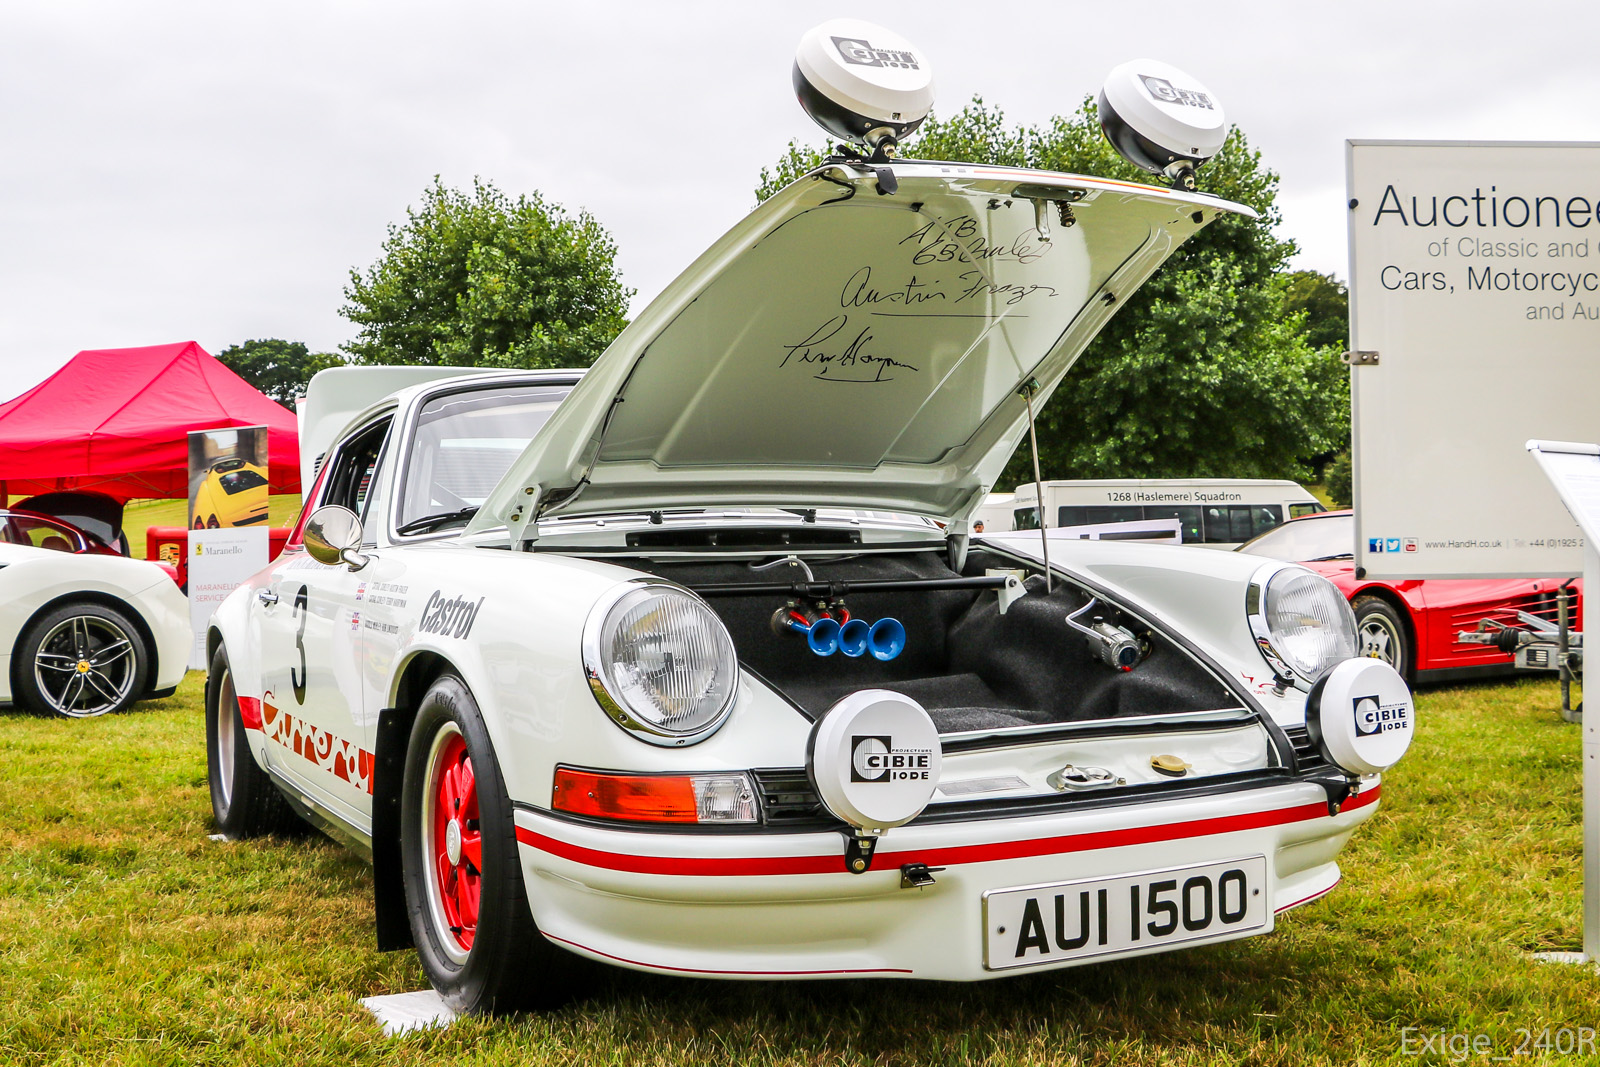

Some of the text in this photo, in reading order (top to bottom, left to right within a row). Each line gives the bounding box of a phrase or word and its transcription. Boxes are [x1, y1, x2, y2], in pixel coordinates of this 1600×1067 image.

[1373, 185, 1600, 228] Auctione
[1428, 237, 1449, 257] of
[1458, 237, 1539, 258] Classic
[1547, 238, 1589, 258] and
[1381, 265, 1599, 297] Cars, Motorcyc
[1526, 302, 1565, 320] and
[1107, 492, 1241, 502] 1268 (Haslemere) Squadron
[206, 545, 243, 555] Maranello
[1425, 539, 1502, 549] www.HandH.co.uk
[1529, 539, 1545, 548] +44
[1547, 538, 1578, 549] (0)1925
[419, 590, 485, 640] Castrol
[291, 585, 308, 706] 3
[1365, 708, 1406, 723] CIBIE
[1383, 721, 1408, 731] IODE
[261, 690, 372, 794] Carrera
[867, 755, 928, 768] CIBIE
[893, 771, 929, 780] IODE
[1015, 869, 1247, 957] AUI 1500
